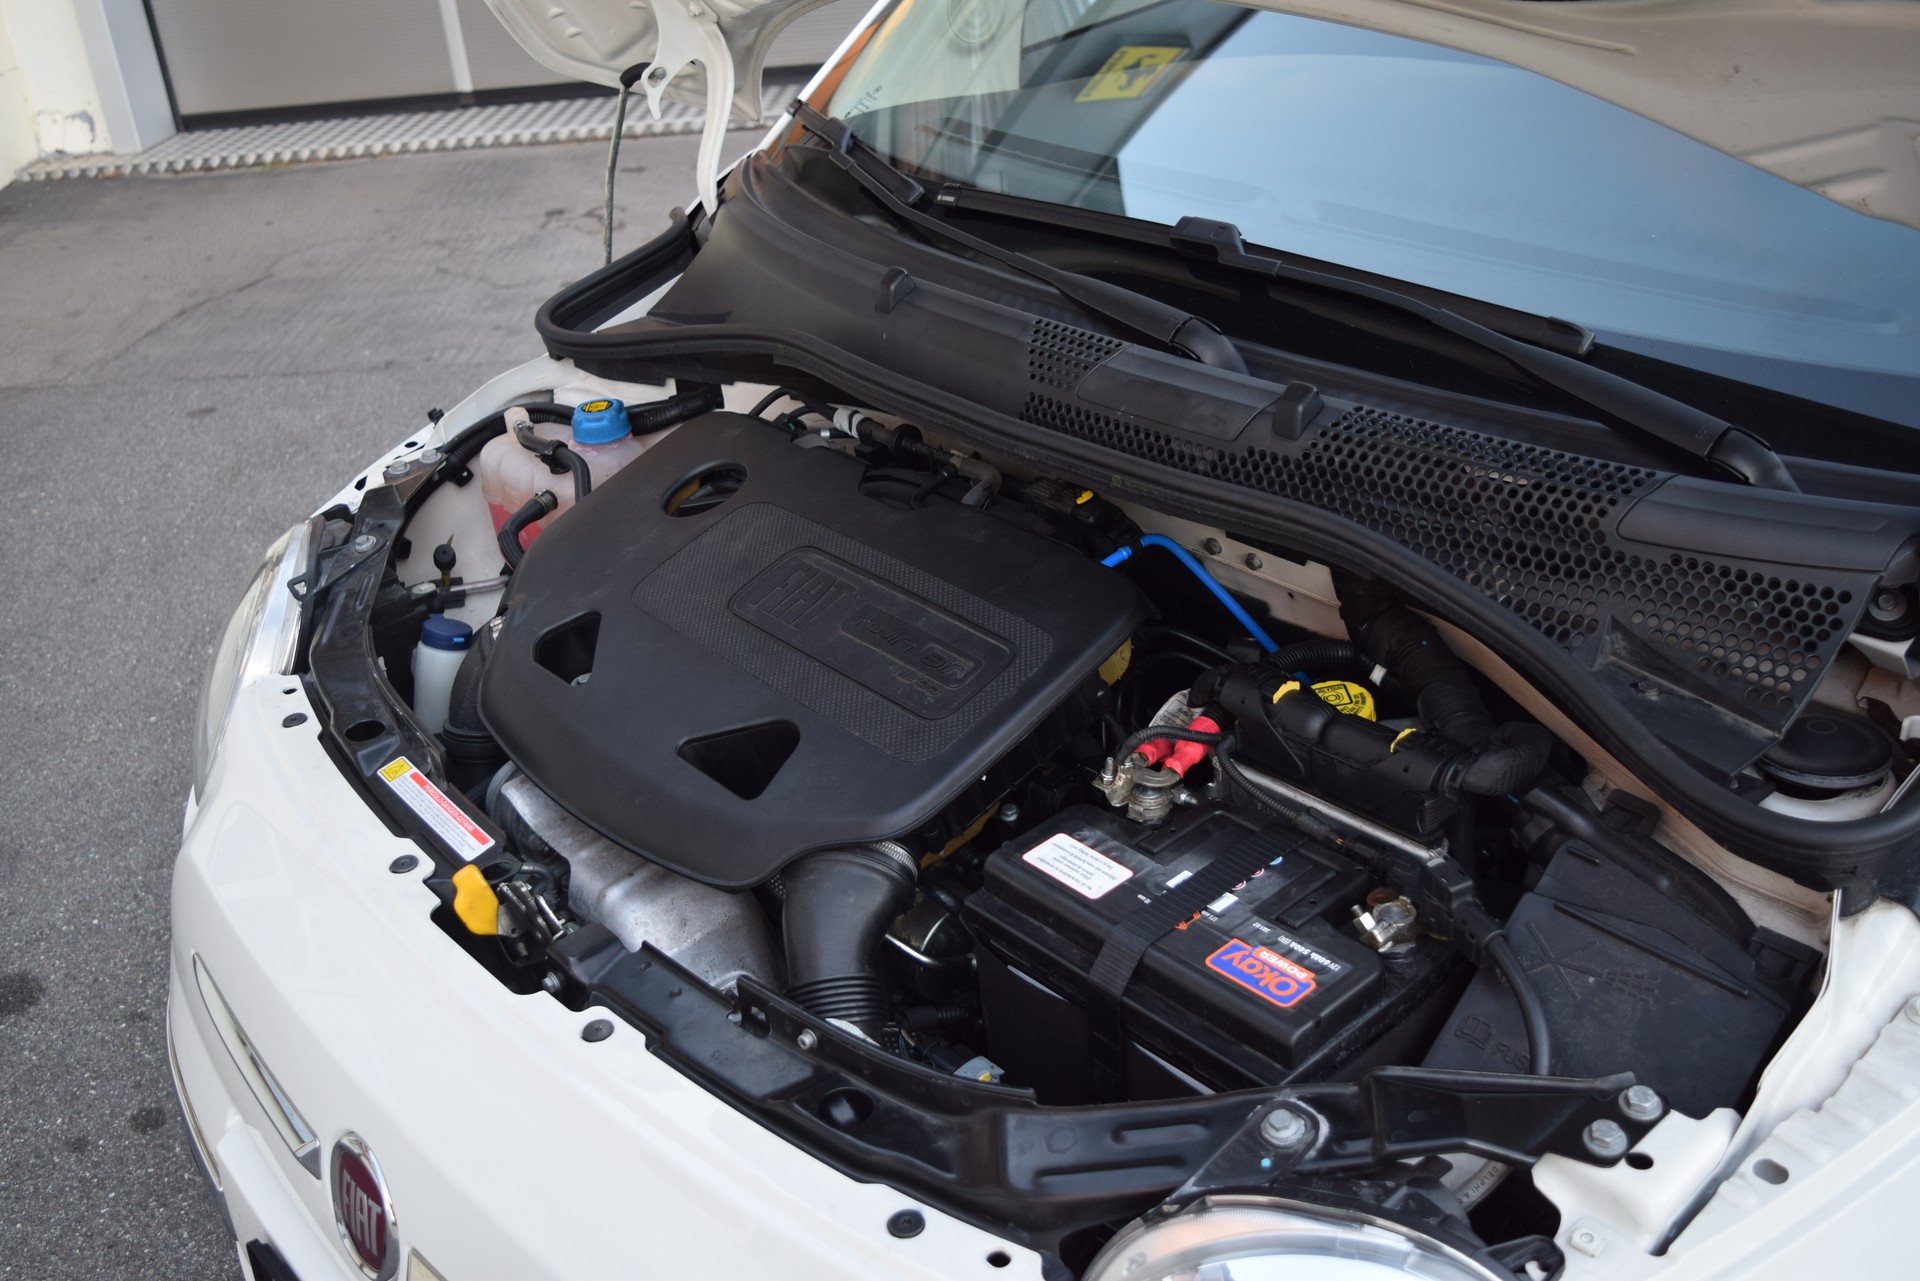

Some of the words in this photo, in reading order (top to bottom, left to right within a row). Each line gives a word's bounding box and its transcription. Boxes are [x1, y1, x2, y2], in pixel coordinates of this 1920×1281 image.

[752, 566, 857, 630] FIAT
[1259, 950, 1308, 979] POWER
[1289, 941, 1311, 955] 540A
[1310, 951, 1332, 967] 60Ah
[1221, 950, 1298, 997] Okay
[343, 1169, 382, 1257] FIAT
